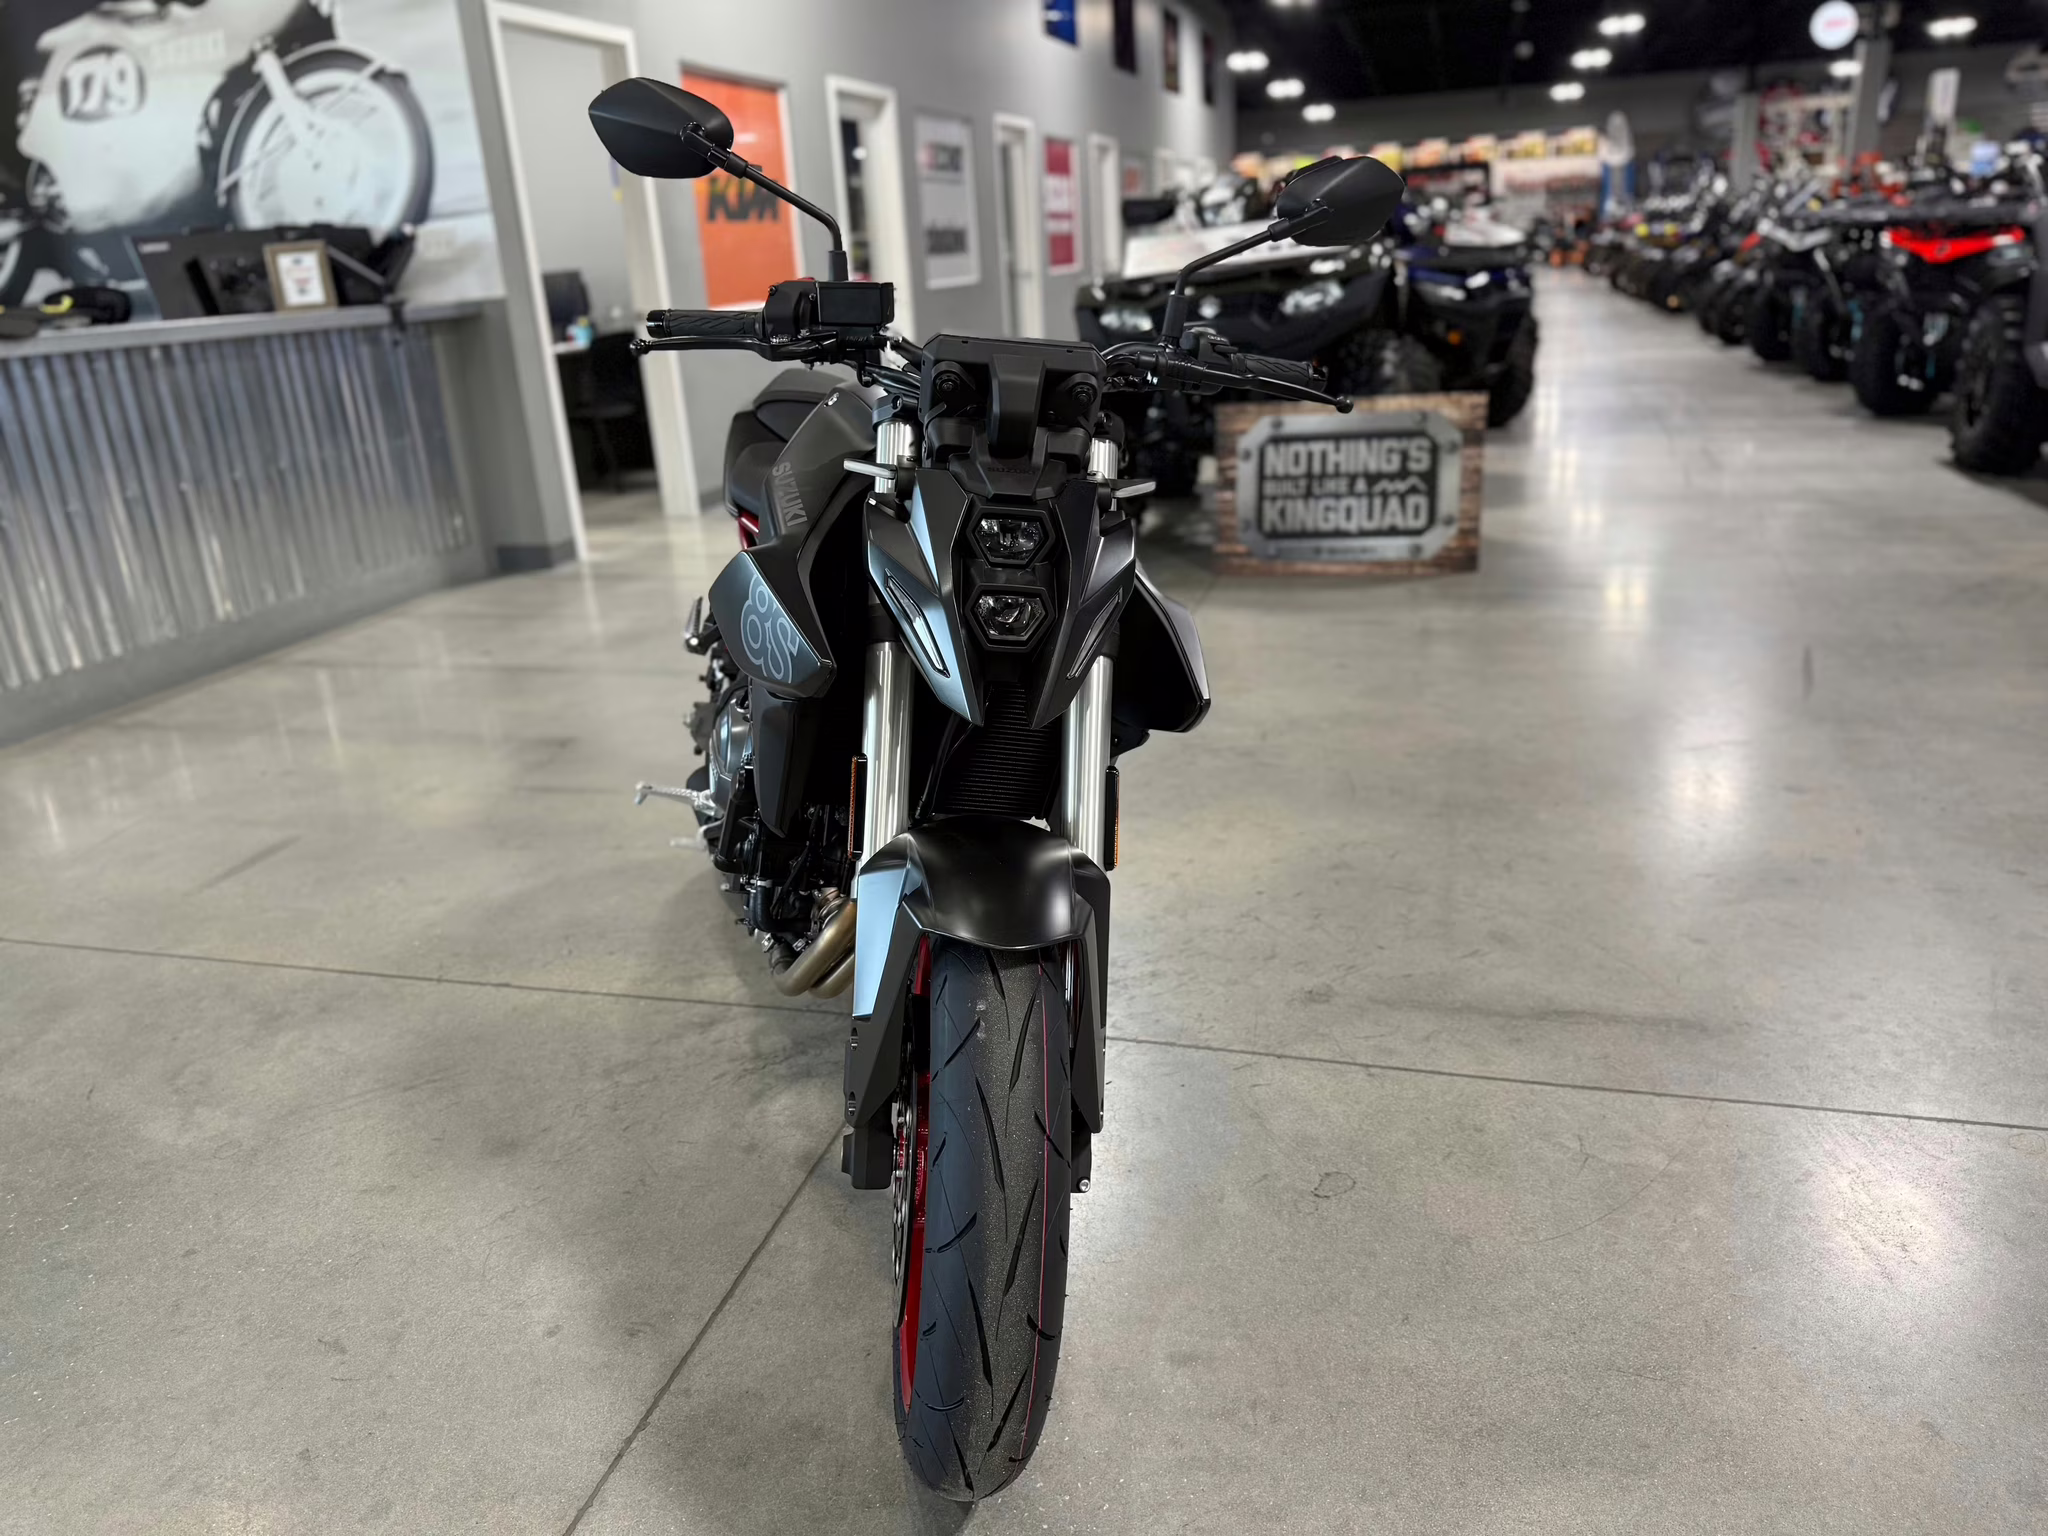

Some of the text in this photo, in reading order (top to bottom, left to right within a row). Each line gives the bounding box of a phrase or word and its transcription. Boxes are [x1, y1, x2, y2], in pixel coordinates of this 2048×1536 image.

[1264, 436, 1433, 476] NOTHING'S
[772, 461, 808, 527] SUZUKI
[1311, 476, 1350, 495] LIKE
[1352, 475, 1369, 494] A
[1262, 494, 1430, 534] KINGQUAD
